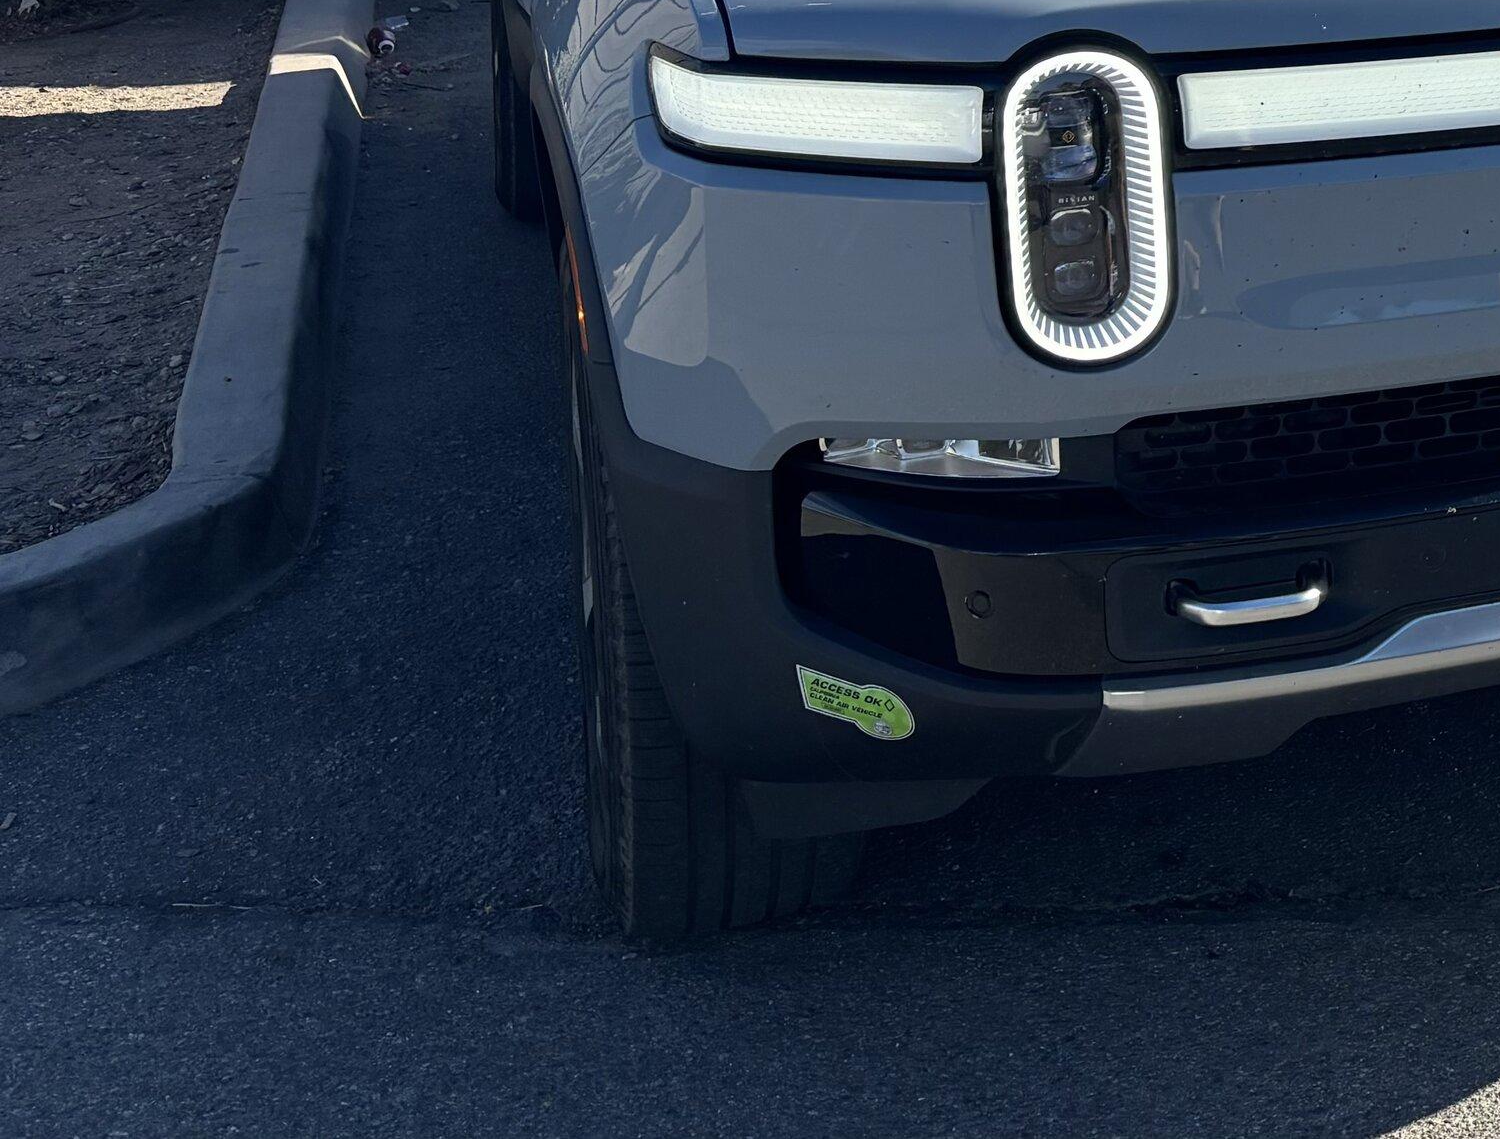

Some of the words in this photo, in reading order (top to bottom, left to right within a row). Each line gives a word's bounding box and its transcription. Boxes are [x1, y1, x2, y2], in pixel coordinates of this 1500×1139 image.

[810, 692, 834, 704] CLEAN
[836, 701, 849, 709] AIR
[852, 705, 883, 718] VEHICLE
[811, 678, 860, 699] ACCESS
[864, 695, 882, 706] OK
